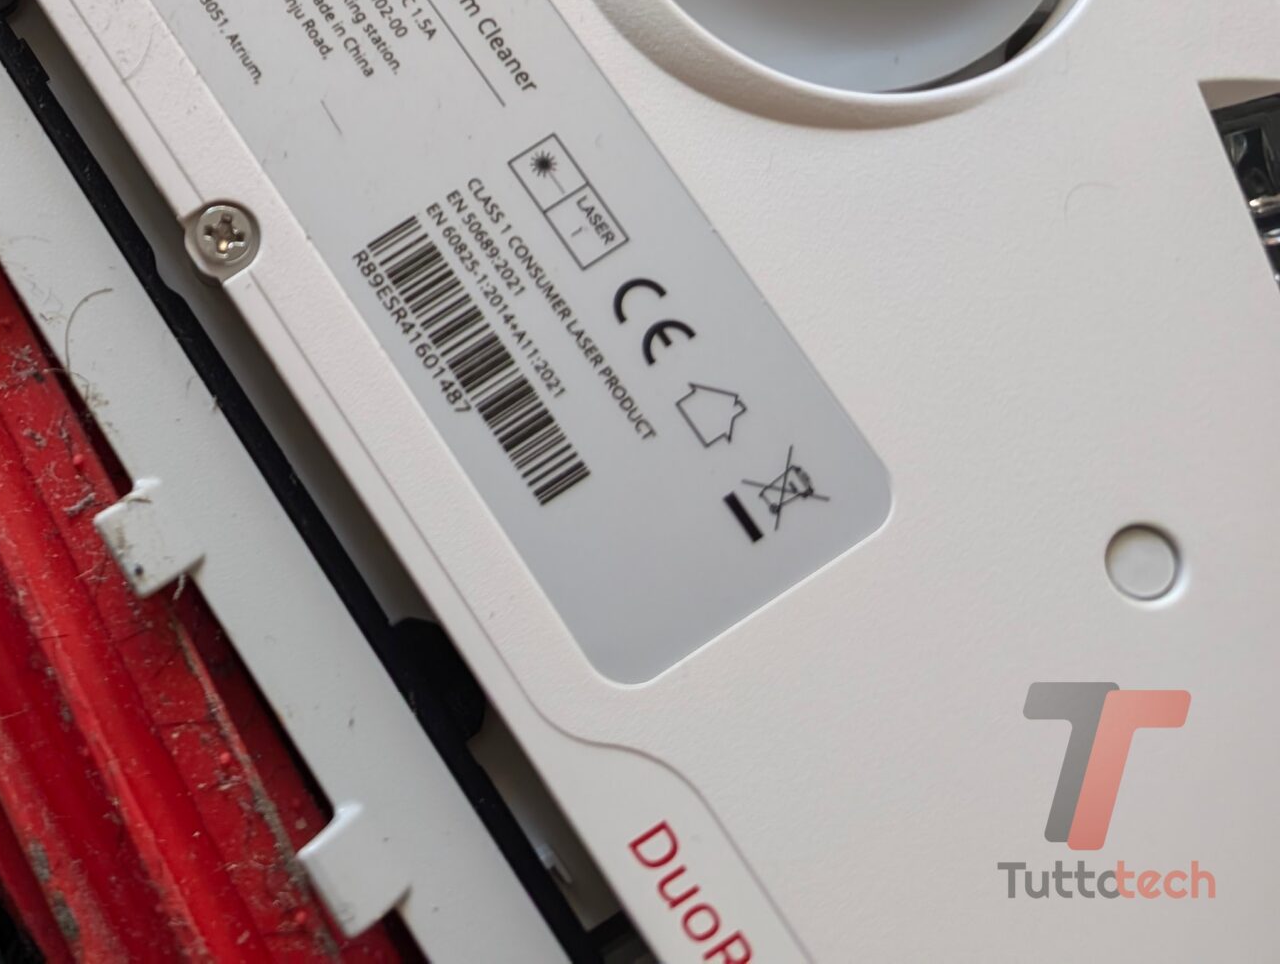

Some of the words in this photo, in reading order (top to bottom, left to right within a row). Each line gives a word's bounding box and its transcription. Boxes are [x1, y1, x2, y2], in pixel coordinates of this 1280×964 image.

[330, 19, 347, 38] in
[342, 35, 375, 78] China
[361, 22, 401, 75] station.
[410, 6, 437, 41] 1.5A
[476, 16, 537, 91] Cleaner
[425, 201, 448, 227] EN
[445, 188, 468, 214] EN
[461, 211, 526, 296] 50689:2021
[575, 194, 616, 245] LASER
[466, 176, 505, 225] CLASS
[507, 234, 572, 321] CONSUMER
[564, 318, 605, 368] LASER
[597, 364, 657, 440] PRODUCT
[612, 276, 697, 367] CE
